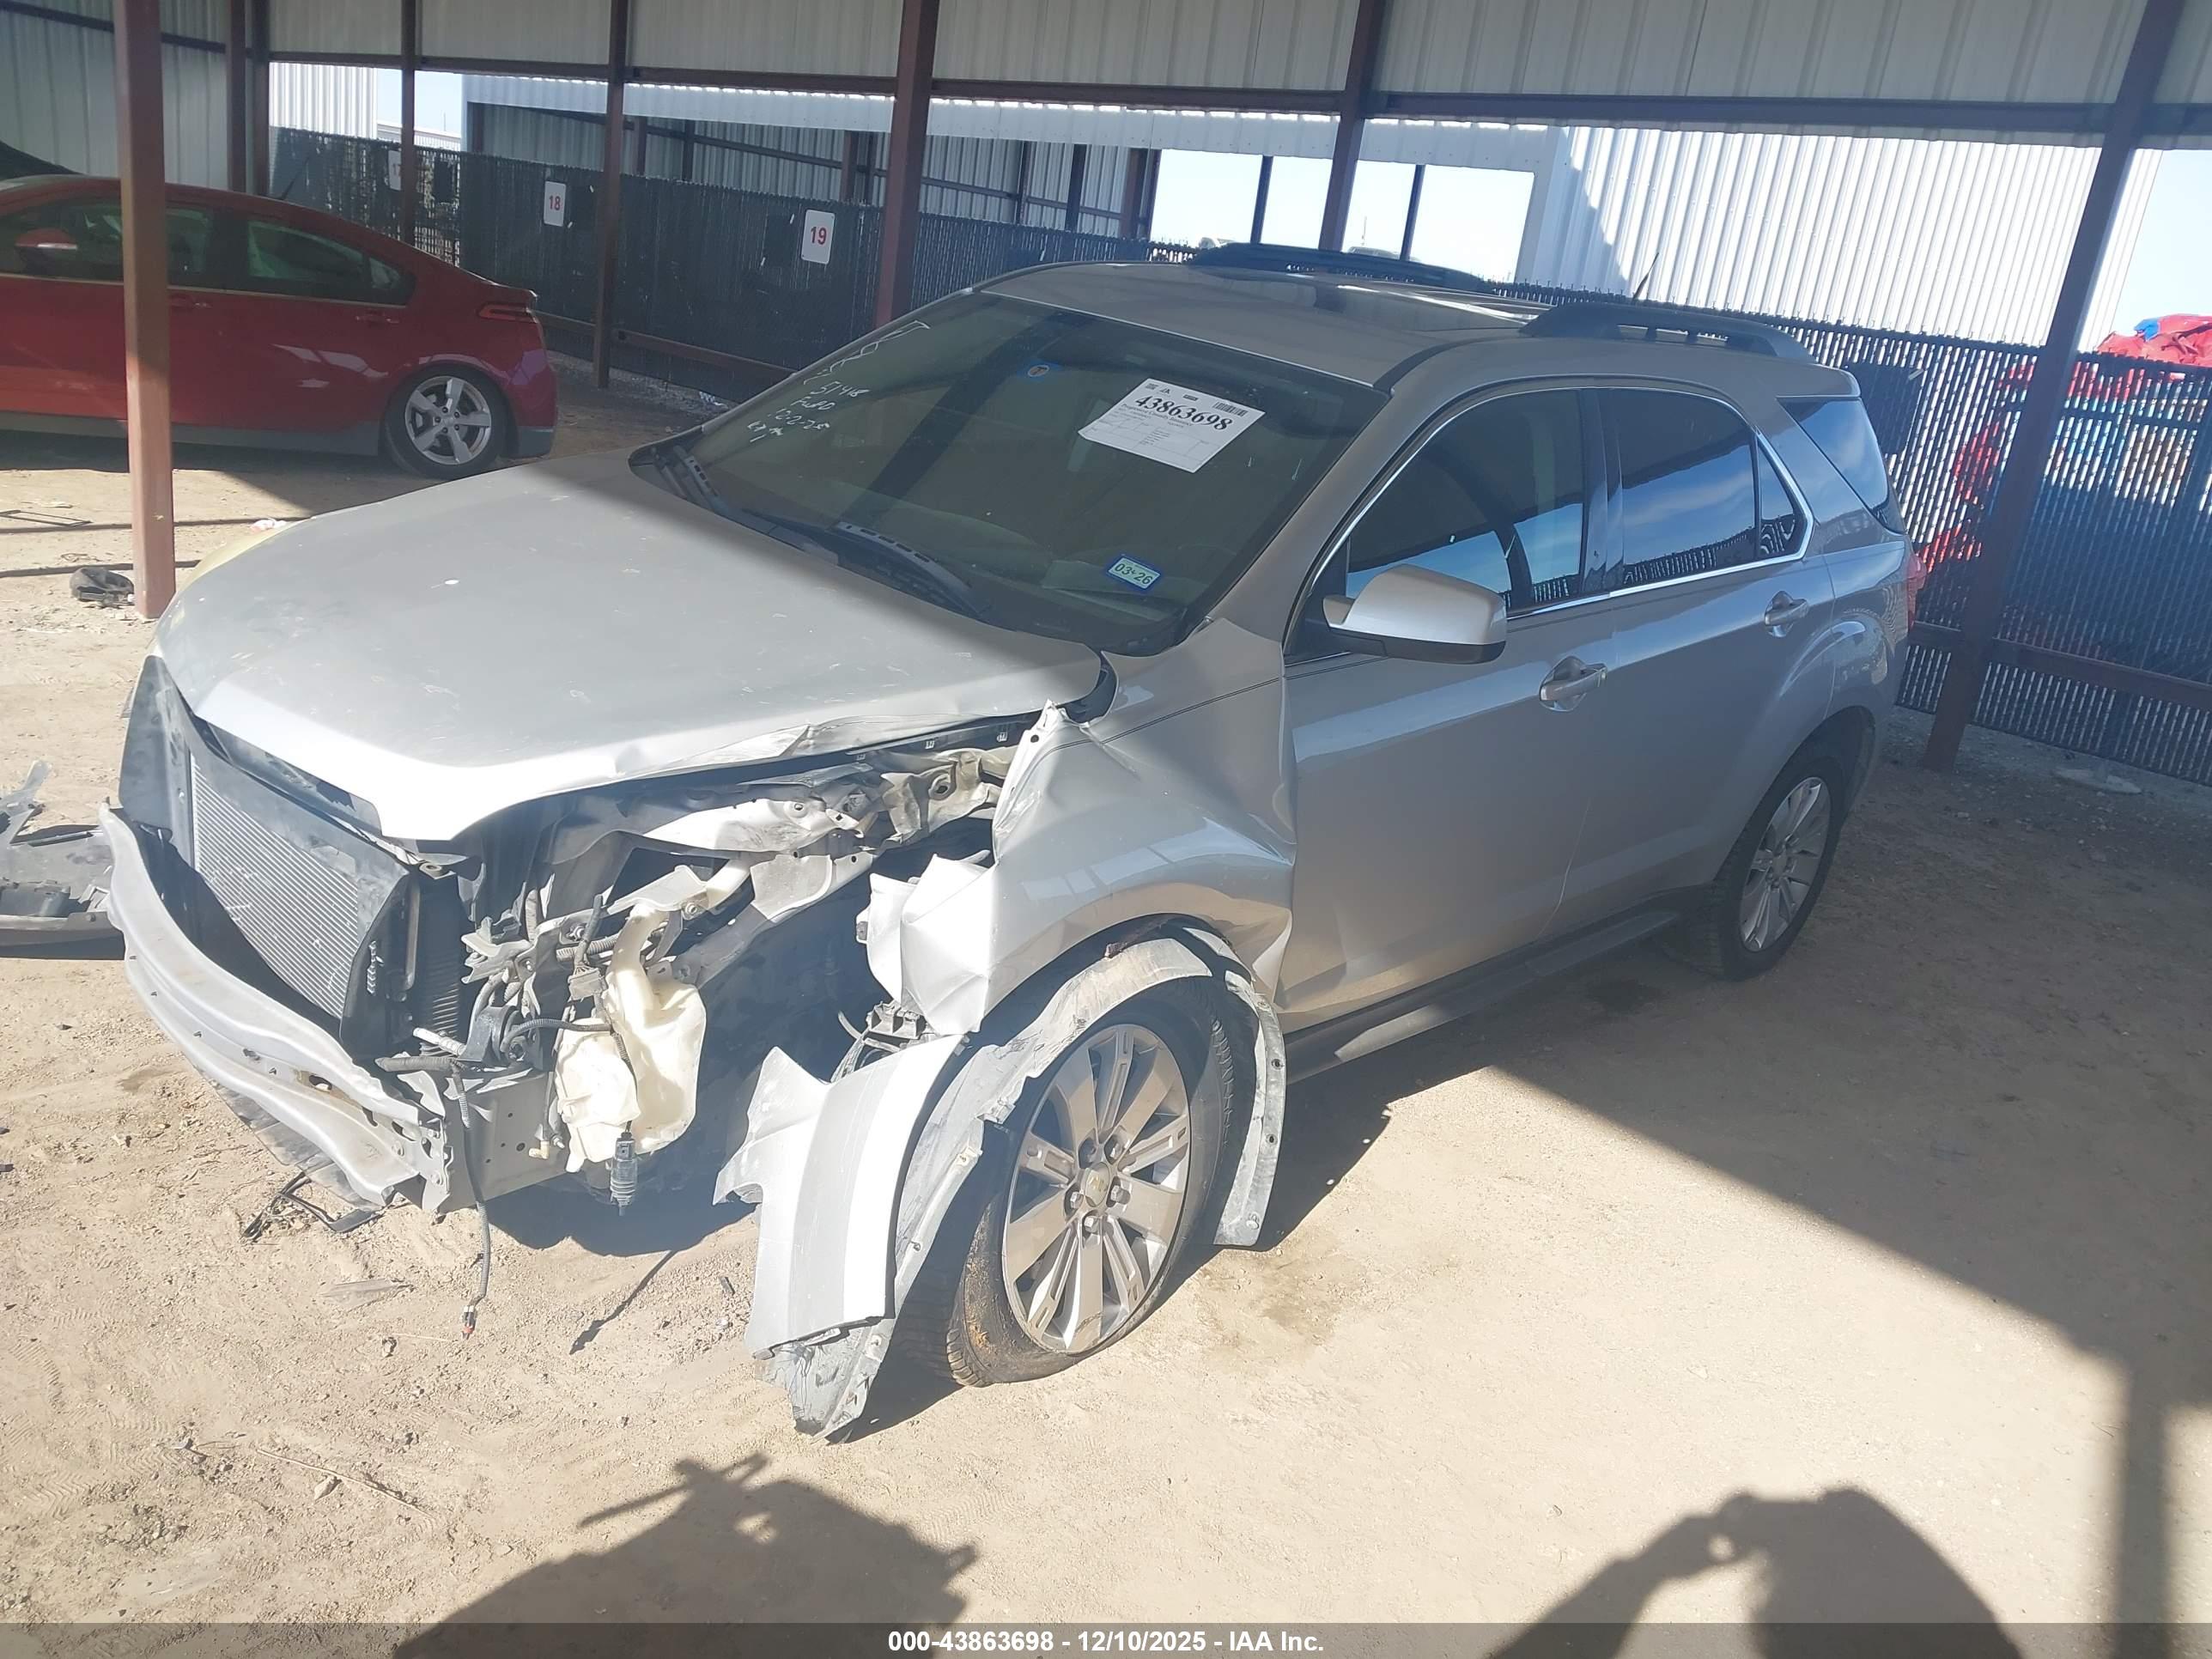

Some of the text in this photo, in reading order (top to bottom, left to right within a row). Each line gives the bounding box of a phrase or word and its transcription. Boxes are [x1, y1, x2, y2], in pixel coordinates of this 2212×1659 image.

[550, 195, 561, 210] 18
[811, 227, 827, 245] 19
[1135, 395, 1233, 430] 43863698
